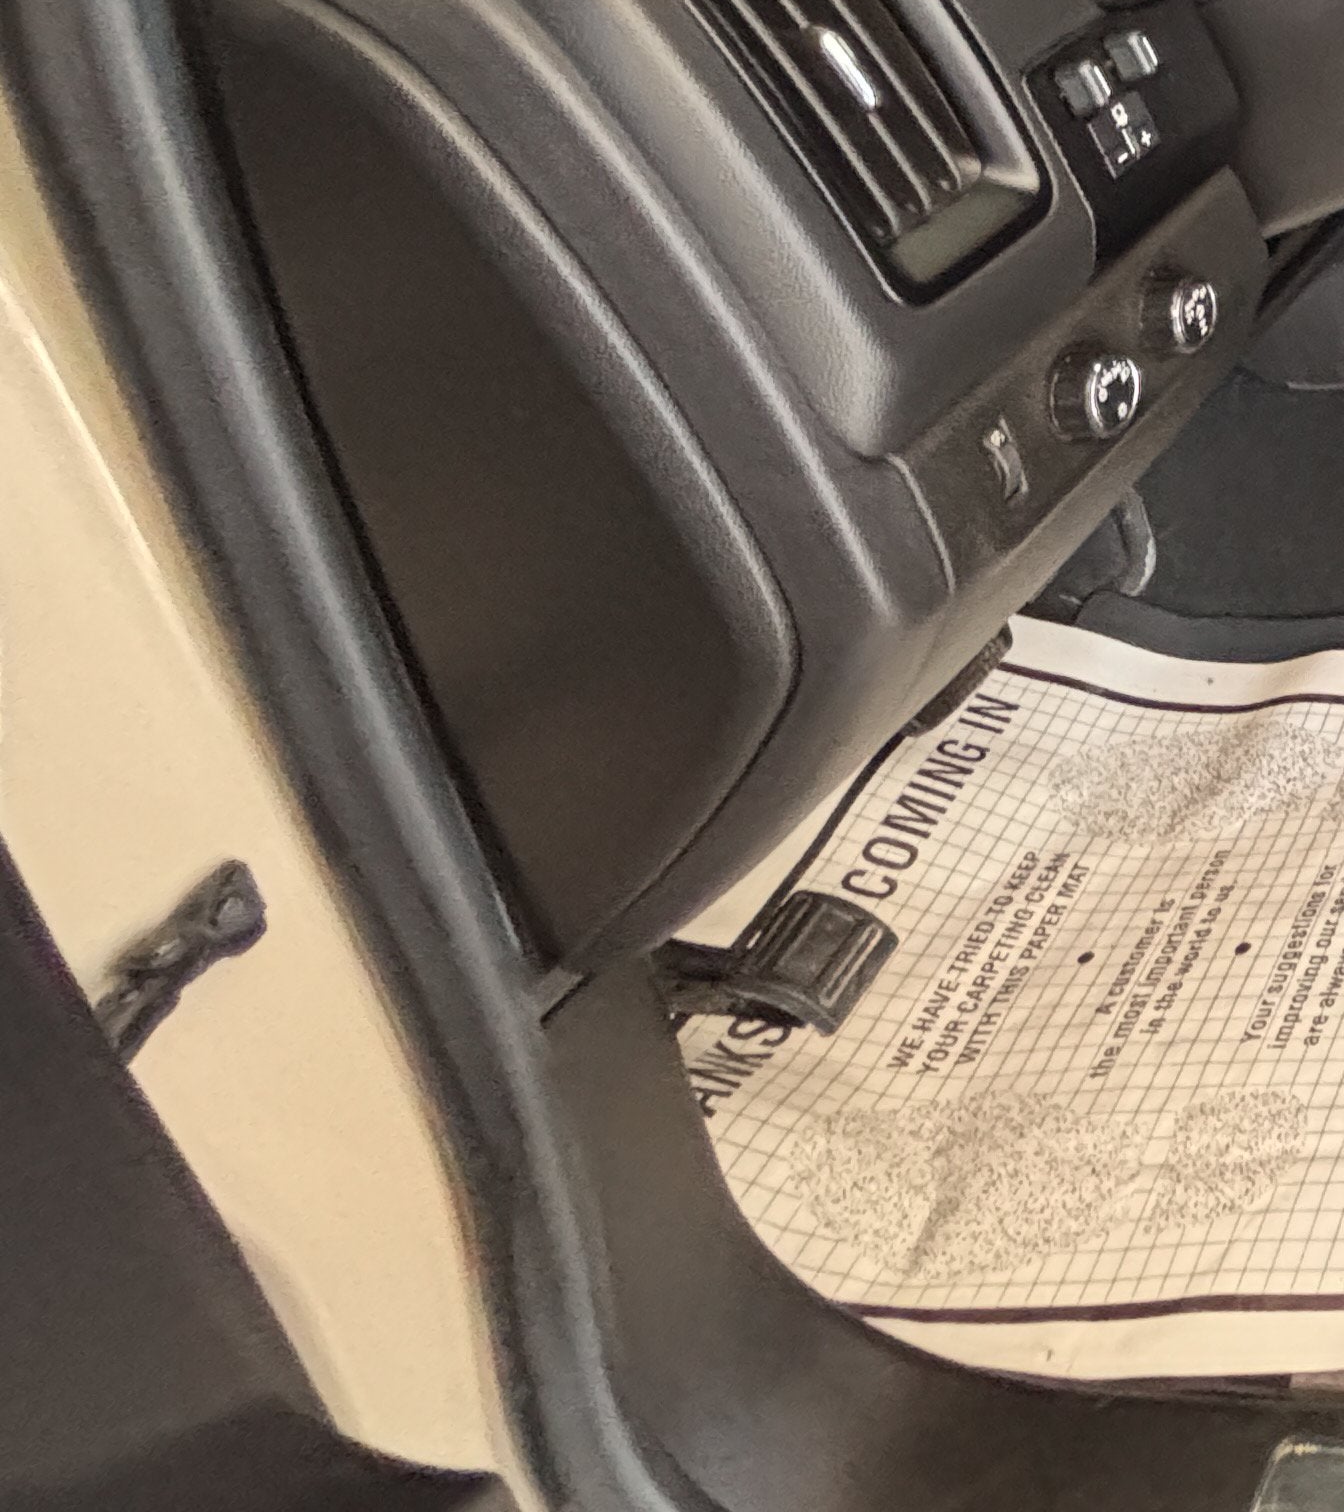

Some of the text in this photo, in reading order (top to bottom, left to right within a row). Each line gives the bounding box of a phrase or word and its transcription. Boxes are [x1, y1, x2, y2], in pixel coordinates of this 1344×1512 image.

[841, 739, 990, 900] COMING
[958, 692, 1021, 734] IN
[887, 851, 1039, 1068] WE HAVE TRIED TO KEEP
[916, 853, 1070, 1074] YOUR CARPETING CLEAN
[956, 862, 1089, 1065] WITH THIS PAPER MAT
[1090, 849, 1231, 1078] the most important person
[1095, 1001, 1117, 1015] A
[1108, 919, 1163, 996] customer
[1154, 980, 1183, 1011] the
[1175, 927, 1211, 976] world
[1202, 907, 1221, 924] to
[1240, 864, 1337, 1044] Your suggestions for
[1267, 954, 1329, 1049] improving
[1317, 919, 1338, 949] our
[1304, 1014, 1329, 1046] are
